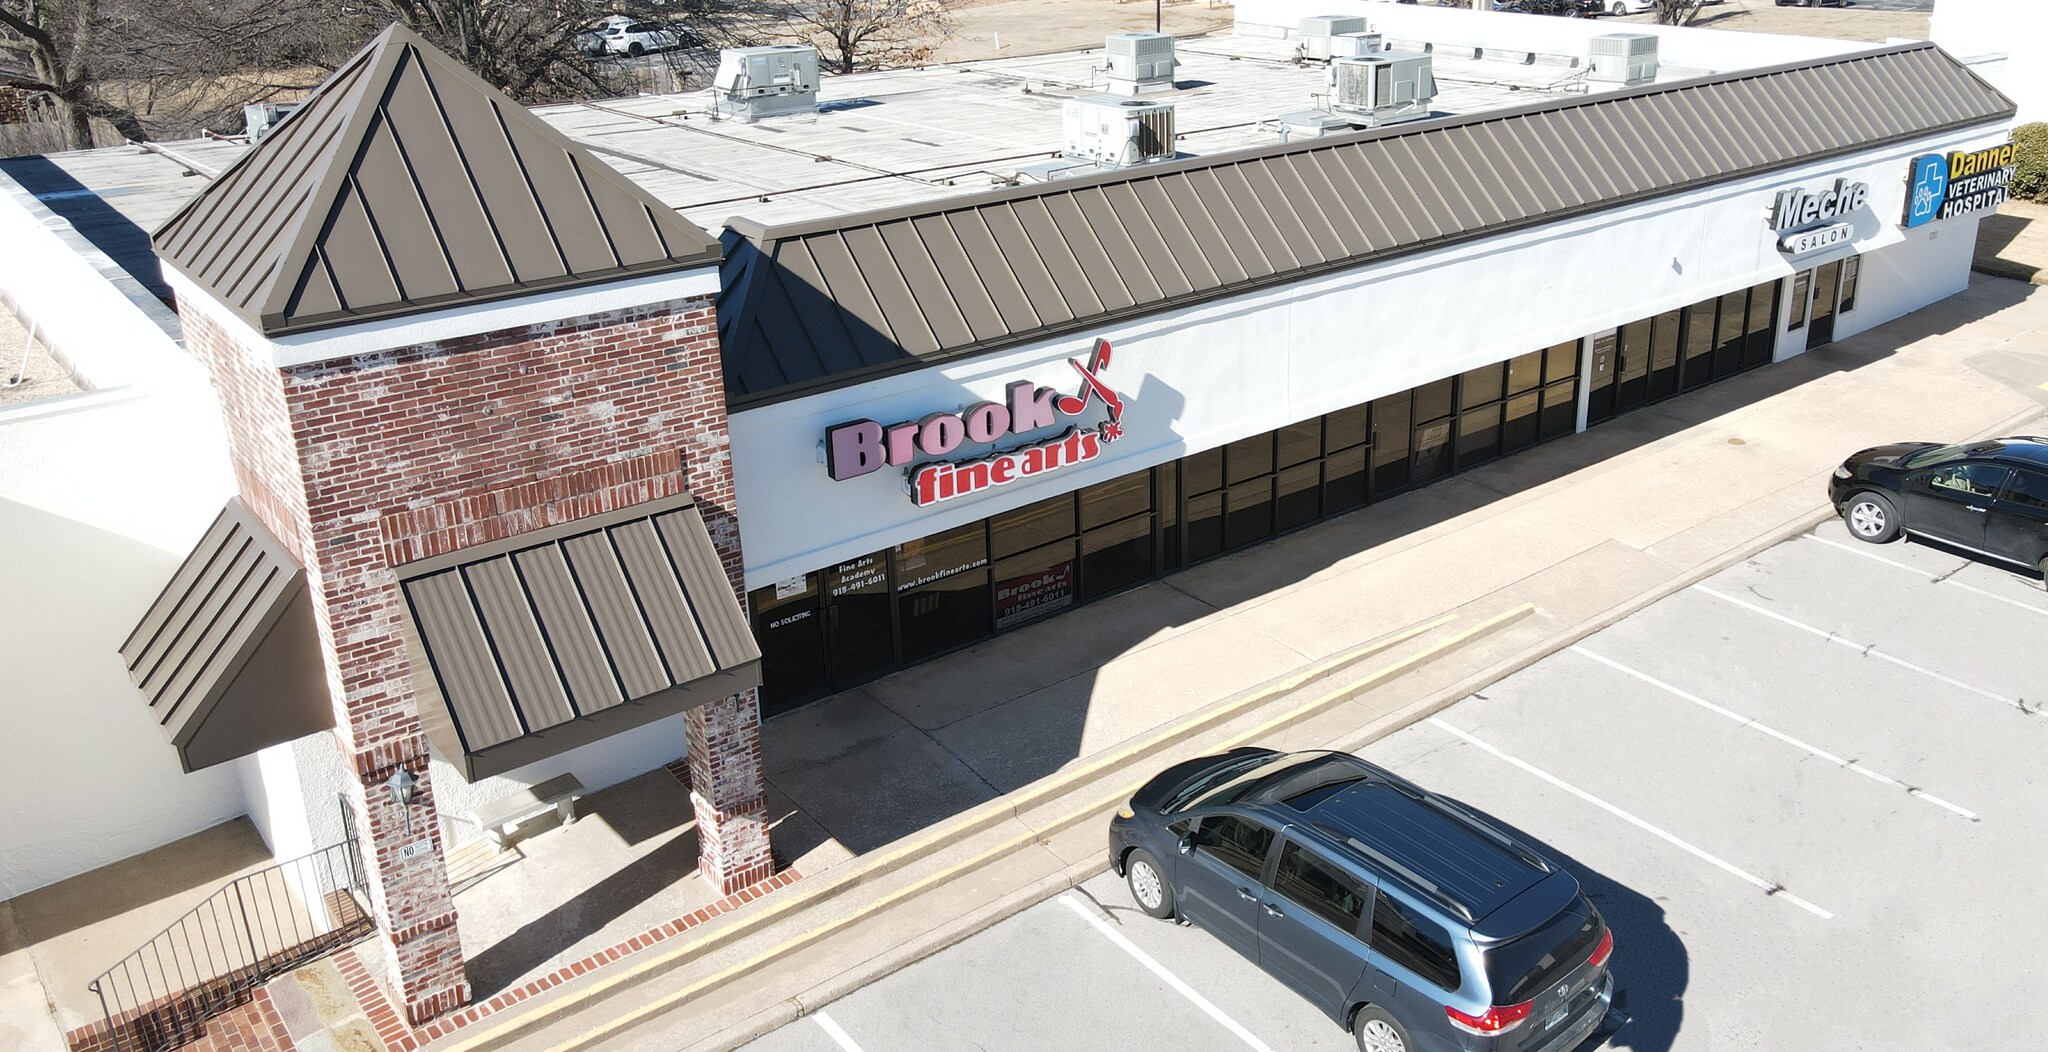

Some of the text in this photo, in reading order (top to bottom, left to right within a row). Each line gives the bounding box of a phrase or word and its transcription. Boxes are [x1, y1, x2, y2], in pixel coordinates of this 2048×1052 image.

[1950, 143, 2019, 180] Danner
[1949, 166, 2016, 199] VETERINARY
[1775, 177, 1869, 231] Meche
[1943, 186, 2010, 220] HOSPITAL
[1801, 228, 1848, 251] SALON
[828, 380, 1056, 481] Brook
[839, 558, 873, 573] Fine Arts
[841, 568, 876, 583] Academy
[897, 559, 987, 592] www.brookfinearts.com
[833, 574, 885, 596] 918-491-6011
[998, 574, 1055, 600] Brook
[1004, 589, 1064, 616] 918-491-6011
[770, 611, 811, 629] NO SOLICITING
[404, 846, 414, 857] NO
